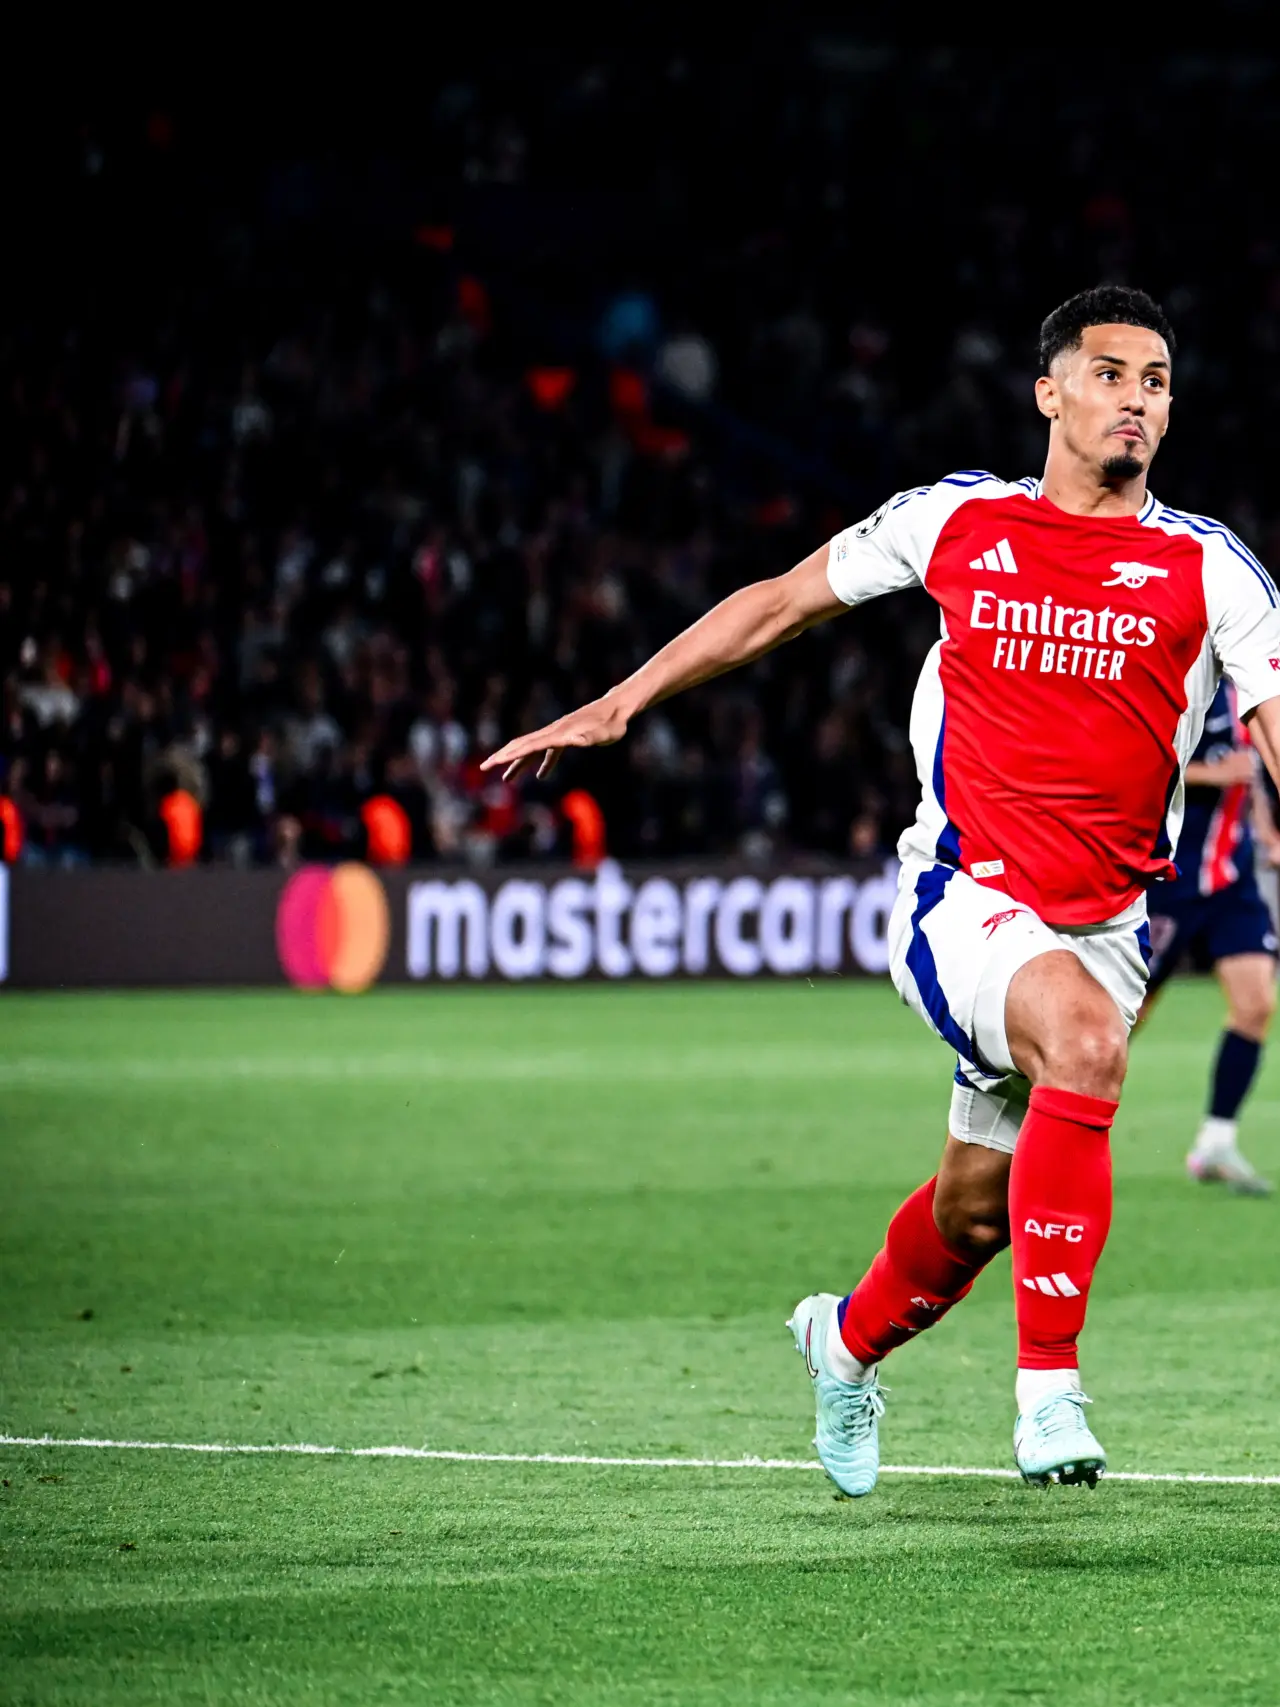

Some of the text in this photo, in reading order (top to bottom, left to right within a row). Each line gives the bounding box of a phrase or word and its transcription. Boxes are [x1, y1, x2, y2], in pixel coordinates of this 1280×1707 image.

[970, 590, 1157, 647] Emirates
[992, 637, 1126, 681] FLY BETTER
[406, 856, 899, 979] mastercard
[1024, 1218, 1084, 1243] AFC
